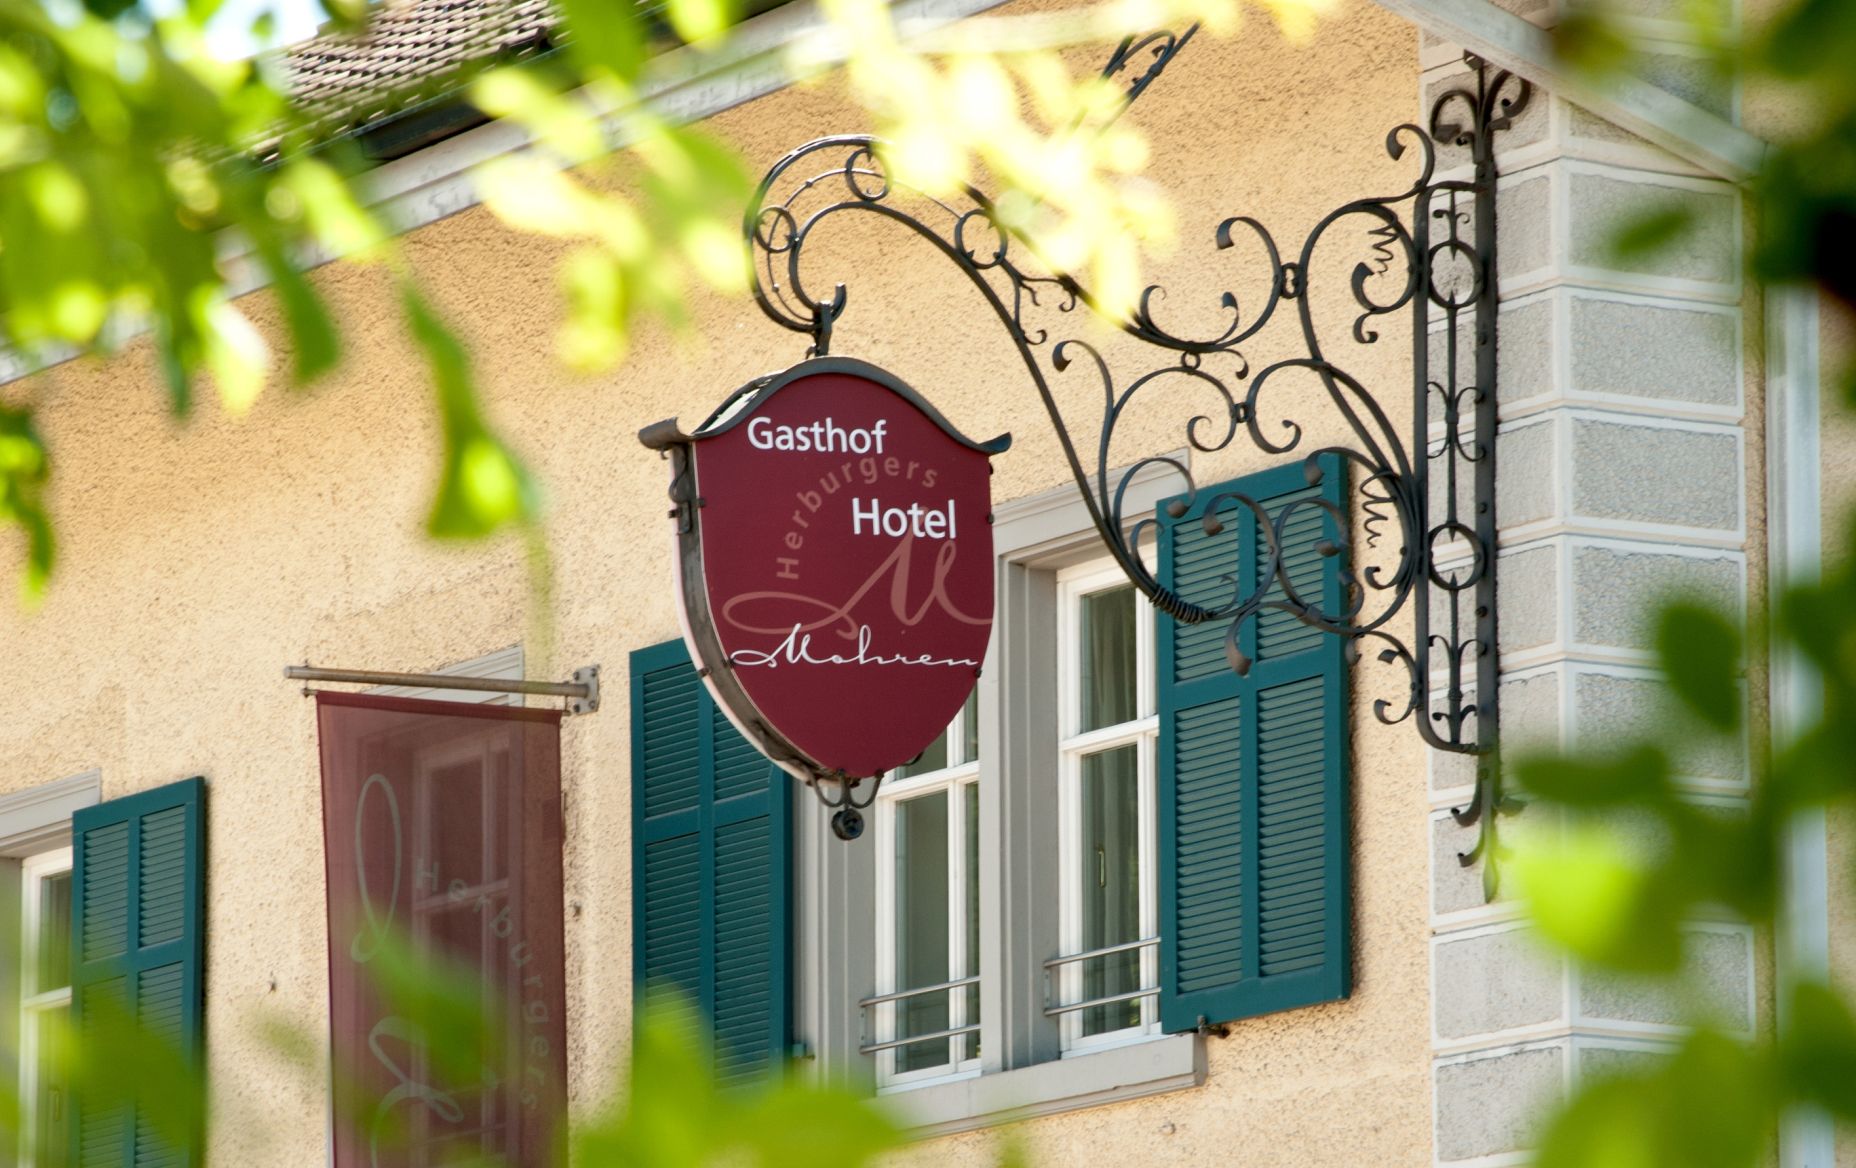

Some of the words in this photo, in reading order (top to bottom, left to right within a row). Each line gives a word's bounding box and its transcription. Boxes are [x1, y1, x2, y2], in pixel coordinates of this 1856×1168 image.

[747, 416, 887, 454] Gasthof
[776, 456, 939, 580] Herburgers
[852, 497, 957, 539] Hotel
[730, 623, 979, 669] Mohren
[415, 859, 551, 1110] Herburgers
